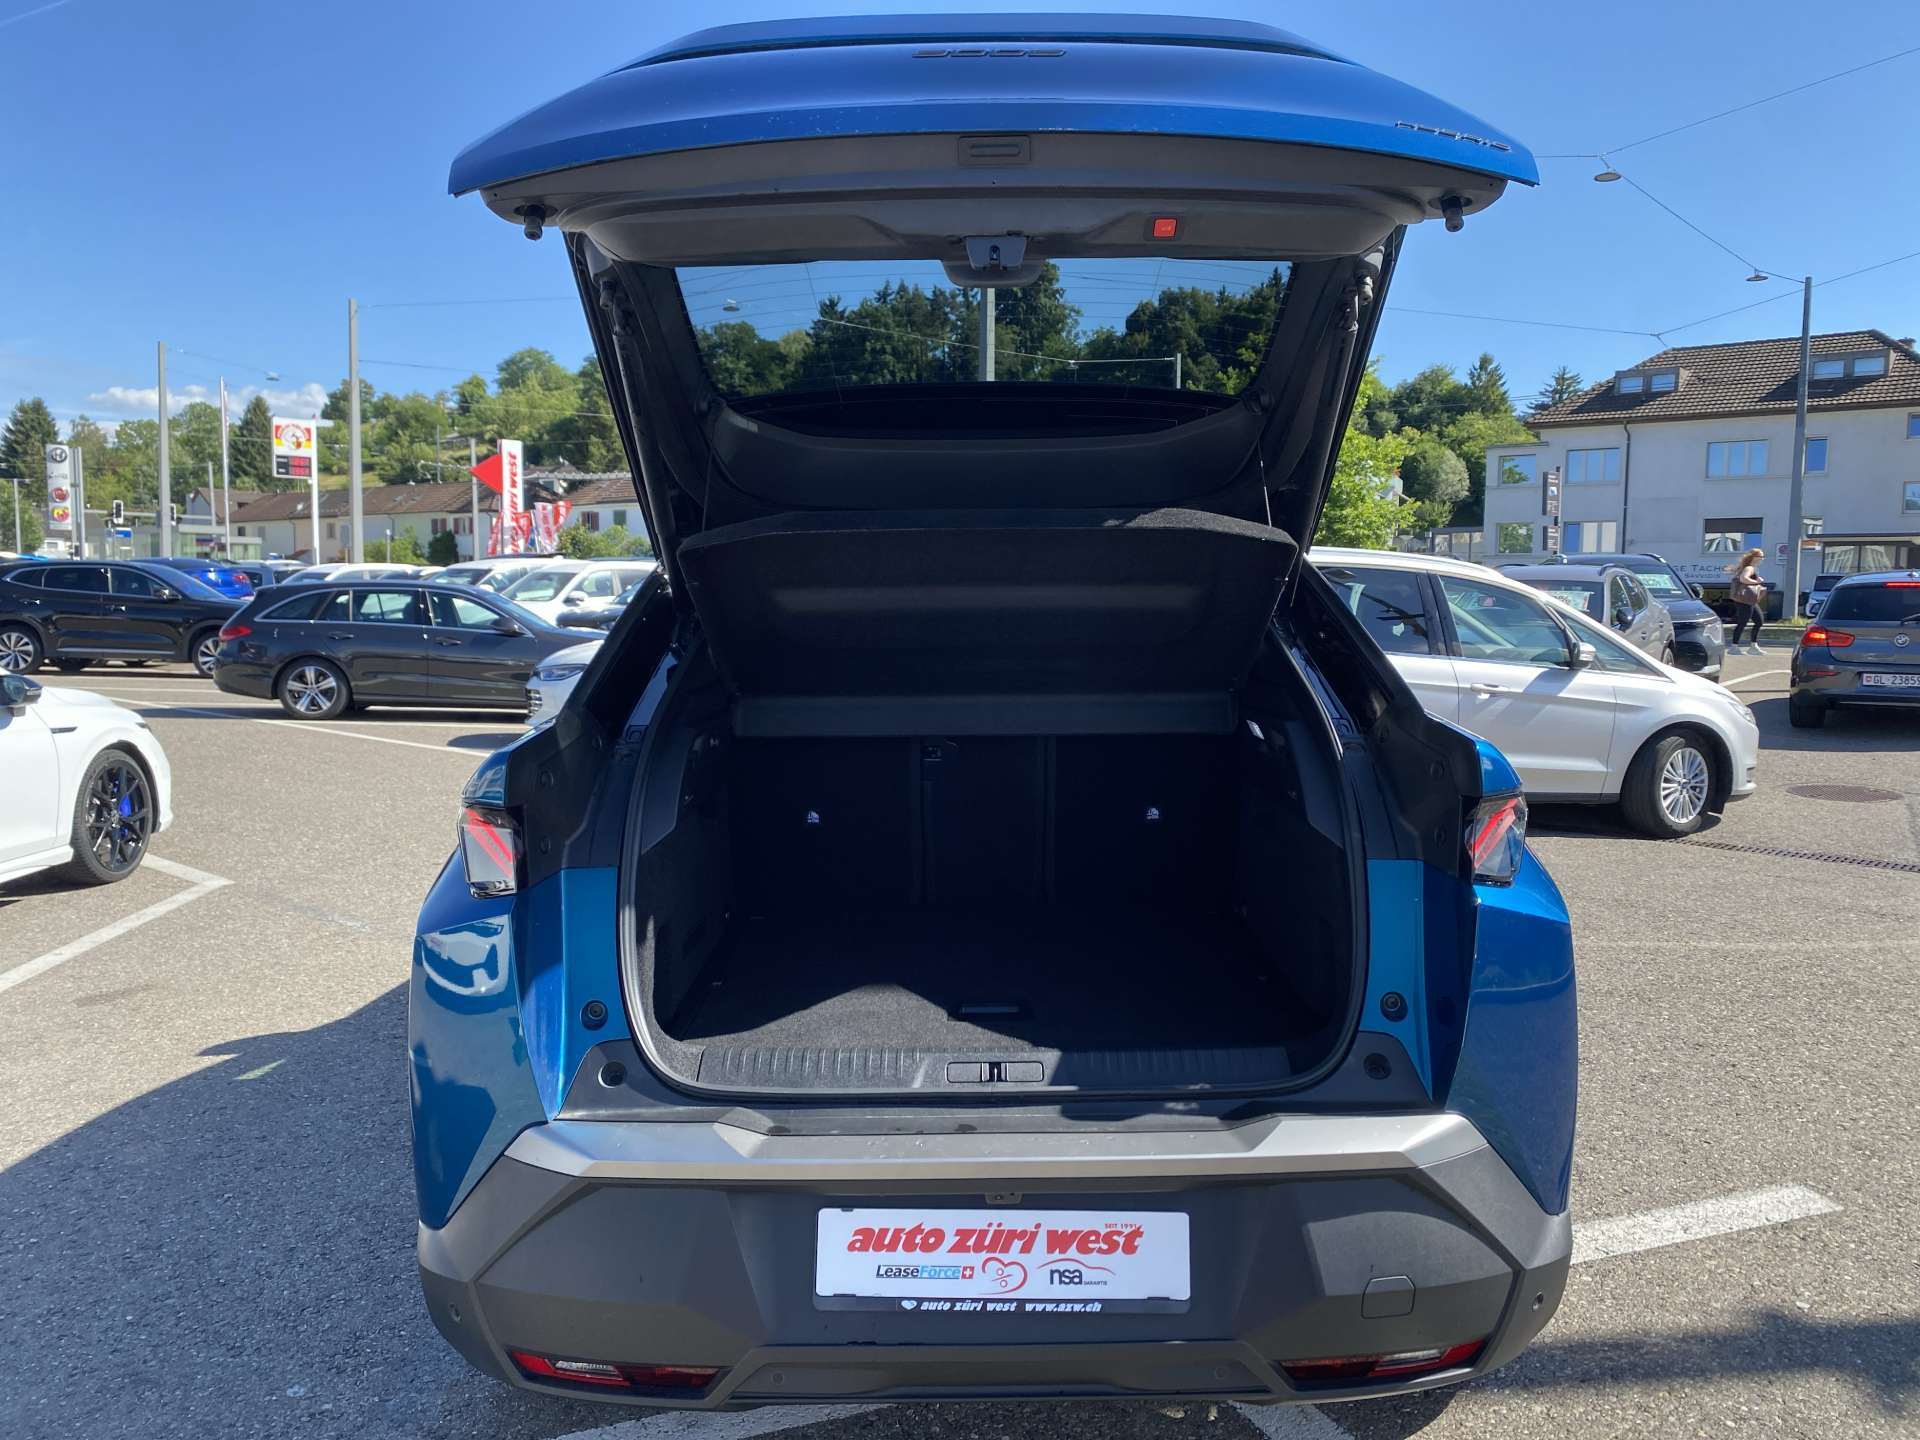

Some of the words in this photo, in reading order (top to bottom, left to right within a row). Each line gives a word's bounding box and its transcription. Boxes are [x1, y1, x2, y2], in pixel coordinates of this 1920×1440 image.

[847, 1222, 946, 1254] auto
[946, 1222, 1041, 1255] züri
[1046, 1223, 1144, 1255] west
[876, 1264, 961, 1280] LeaseForce
[1049, 1268, 1083, 1286] nsa
[920, 1301, 951, 1312] auto
[953, 1299, 984, 1312] züri
[986, 1301, 1017, 1313] west
[1024, 1300, 1103, 1313] www.azw.ch
